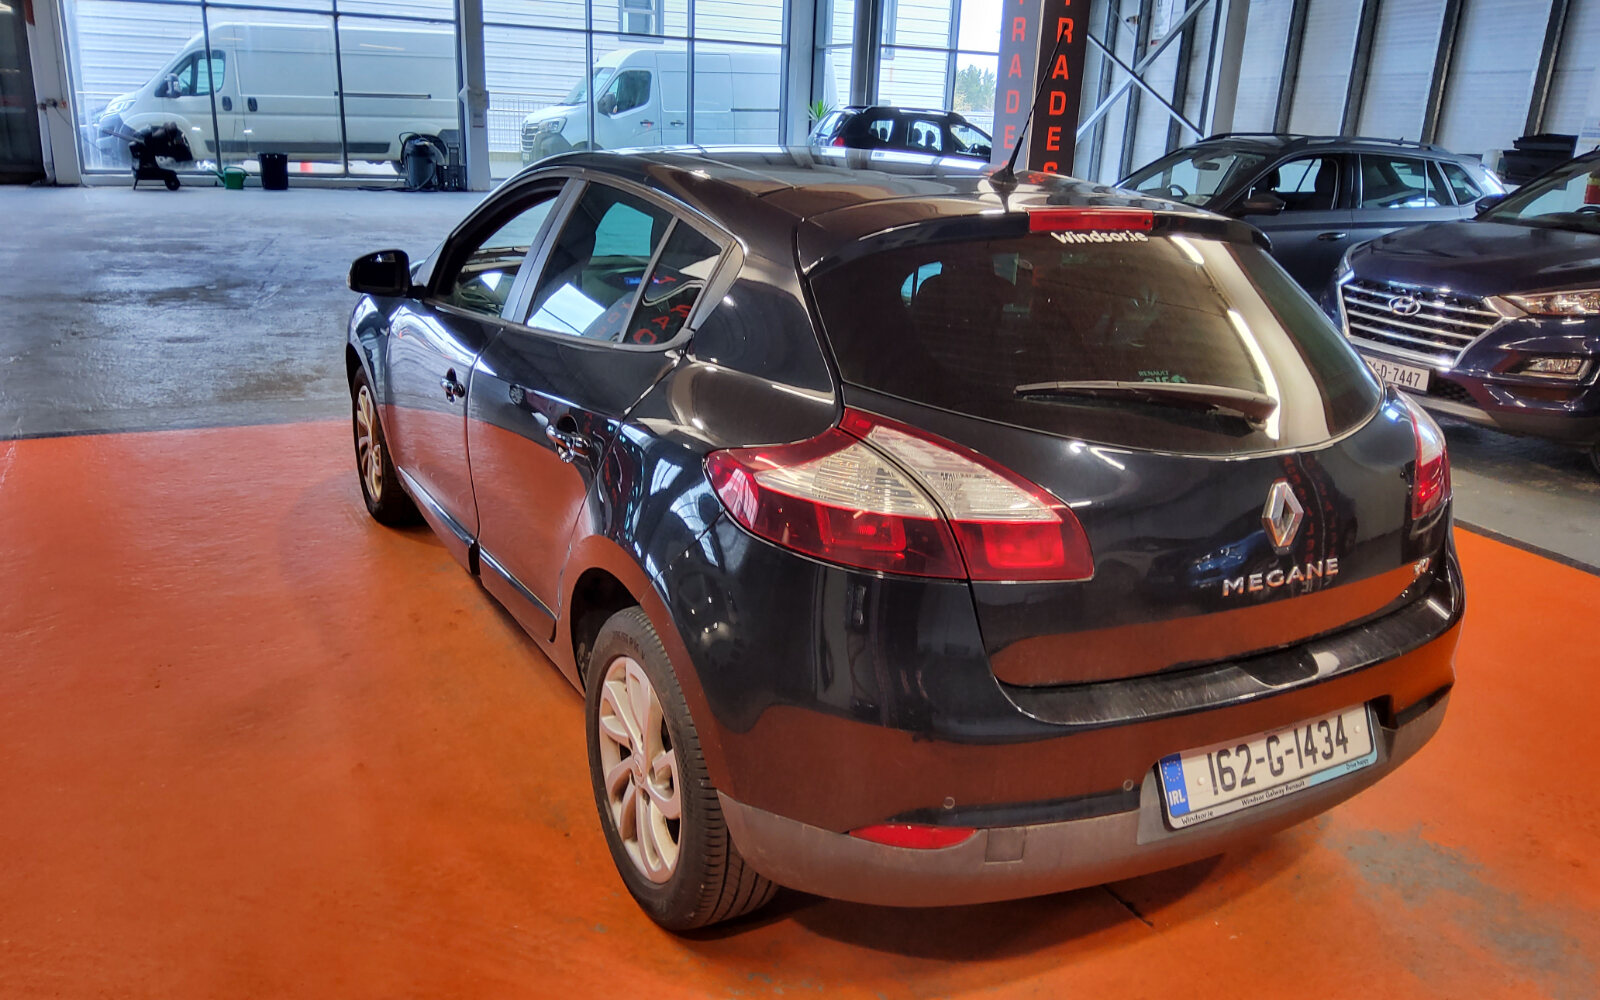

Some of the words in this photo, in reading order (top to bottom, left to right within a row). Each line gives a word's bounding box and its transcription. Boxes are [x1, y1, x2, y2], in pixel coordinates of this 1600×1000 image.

[1000, 0, 1026, 173] RADE
[1043, 0, 1074, 174] RADE
[1051, 229, 1149, 244] Windsor.ie
[1222, 558, 1339, 597] MEGANE
[1207, 715, 1349, 796] 162-G-1434
[1168, 789, 1186, 807] IRL
